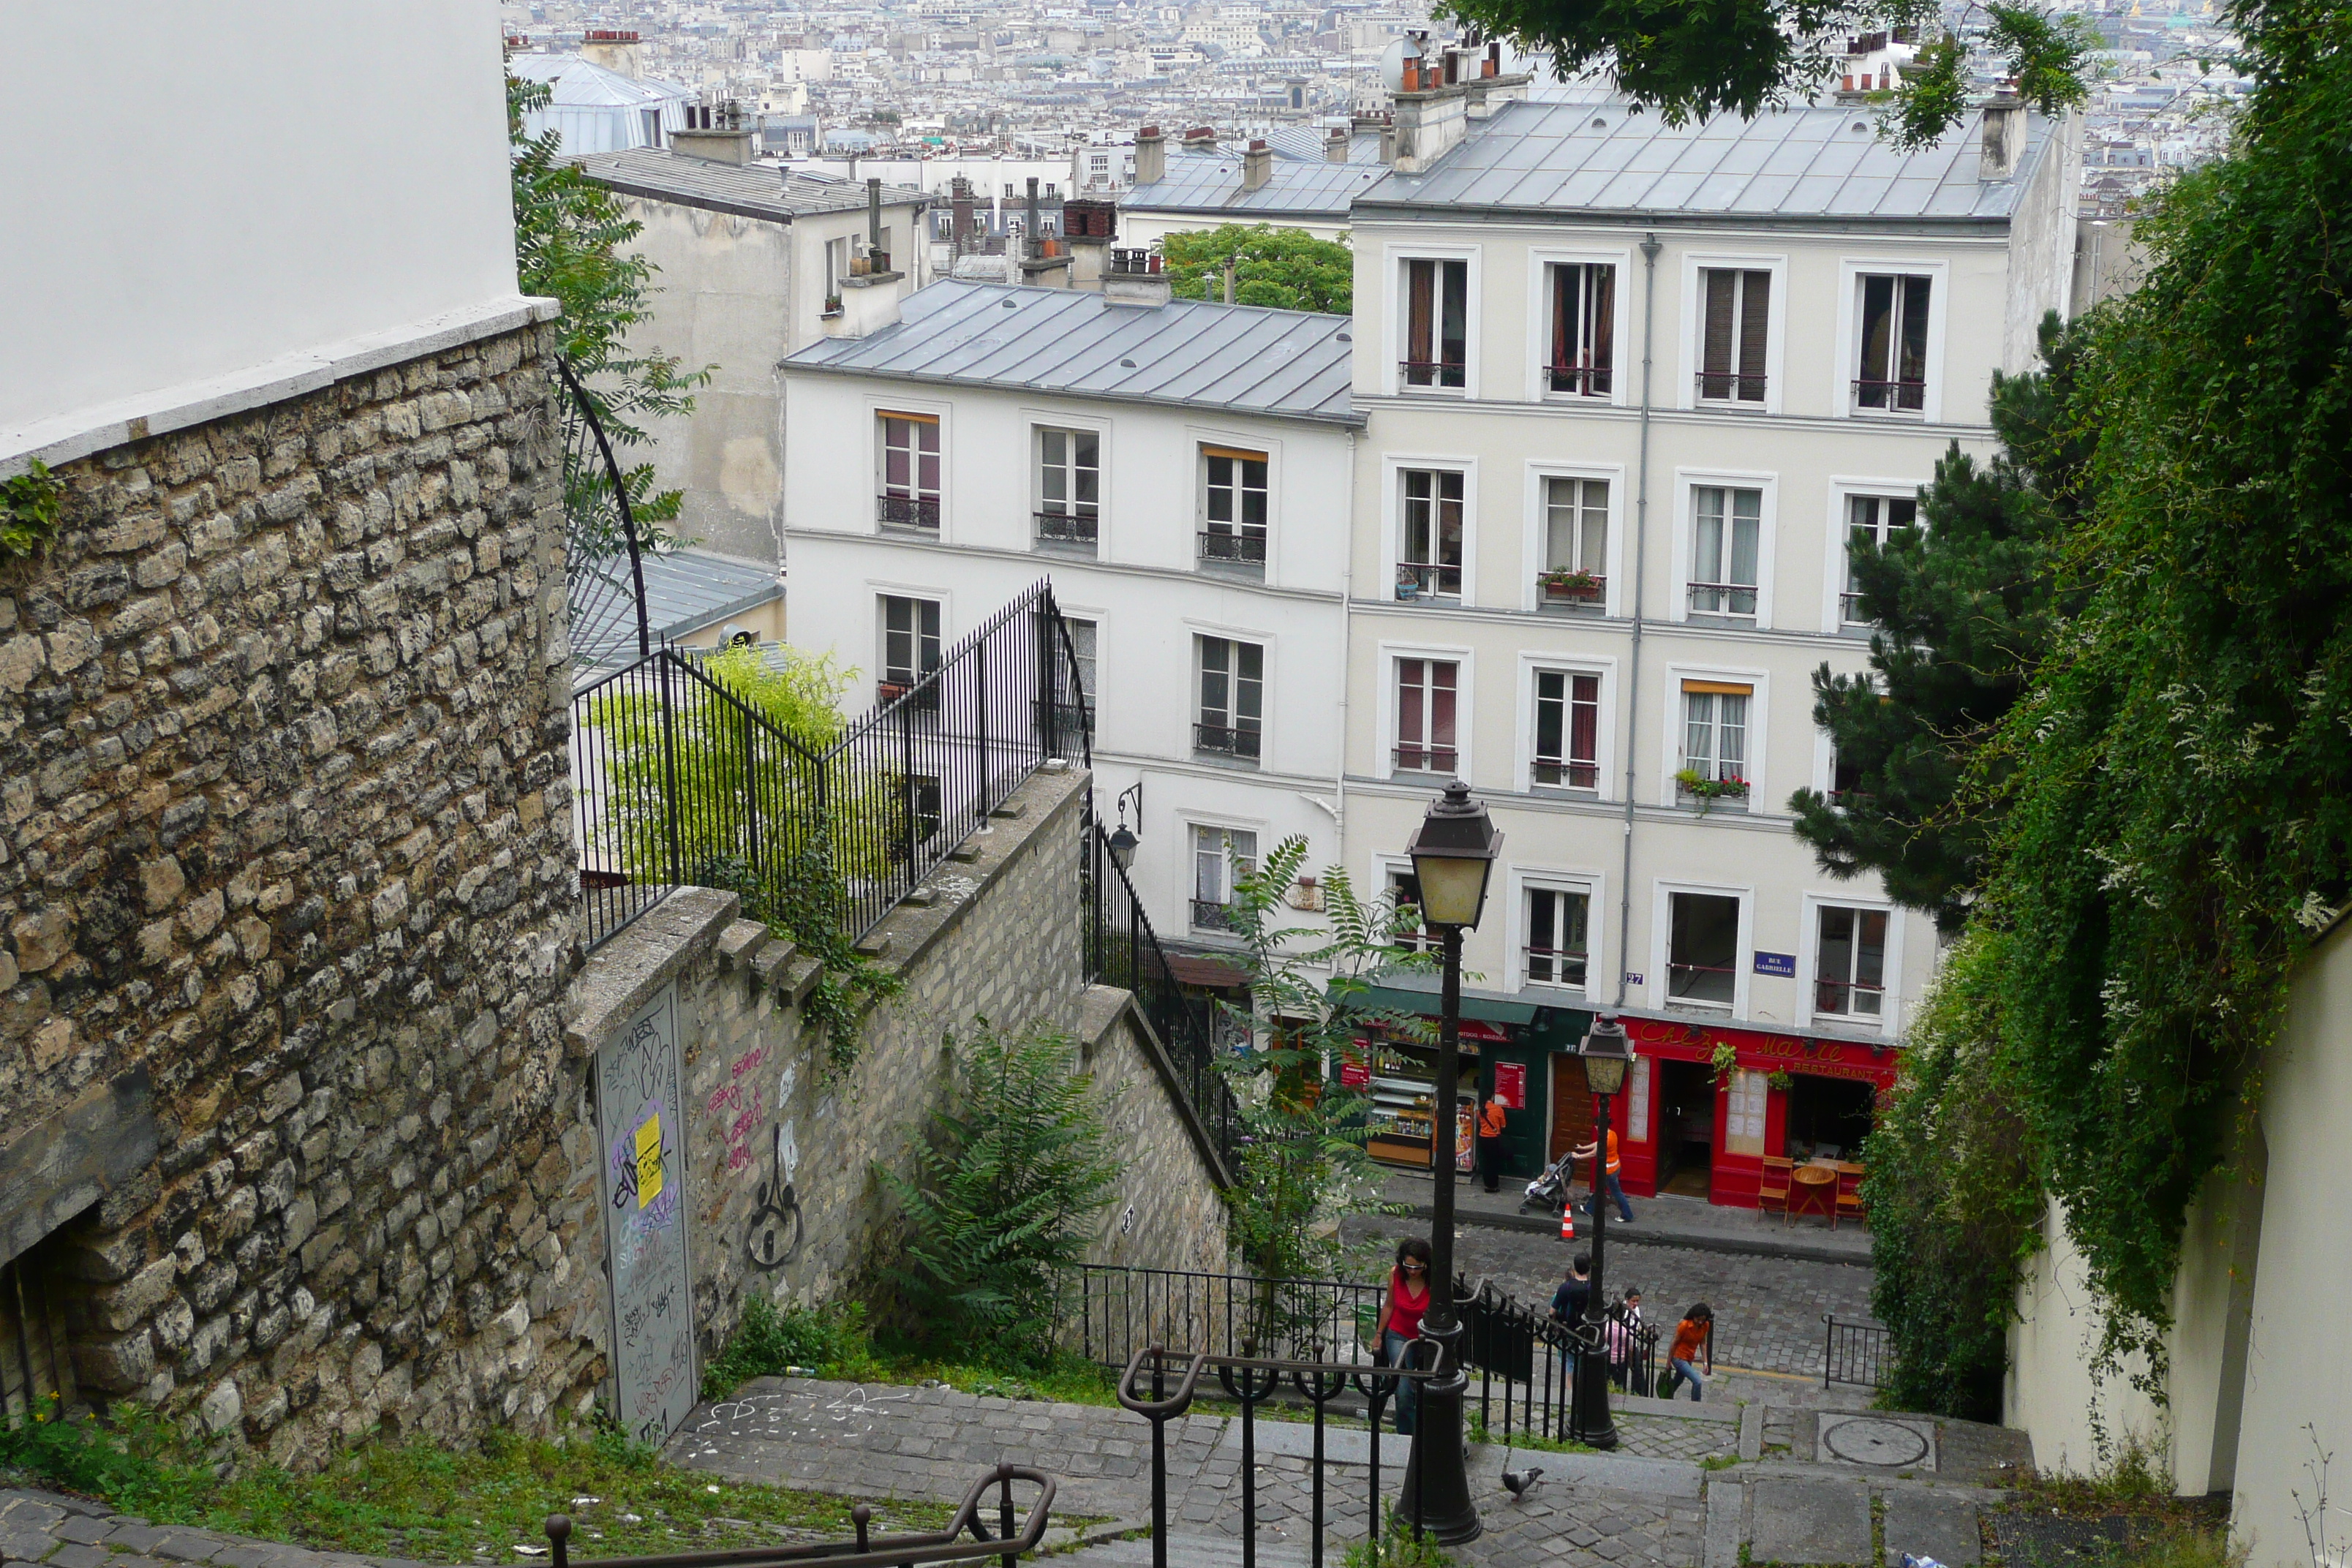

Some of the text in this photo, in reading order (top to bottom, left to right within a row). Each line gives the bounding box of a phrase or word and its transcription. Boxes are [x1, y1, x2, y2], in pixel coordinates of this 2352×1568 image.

[589, 878, 606, 888] AMS
[1756, 963, 1793, 973] GABRIELLE
[1627, 973, 1642, 984] 27
[1640, 1022, 1845, 1063] Chez Marie
[1793, 1062, 1874, 1079] RESTAURANT
